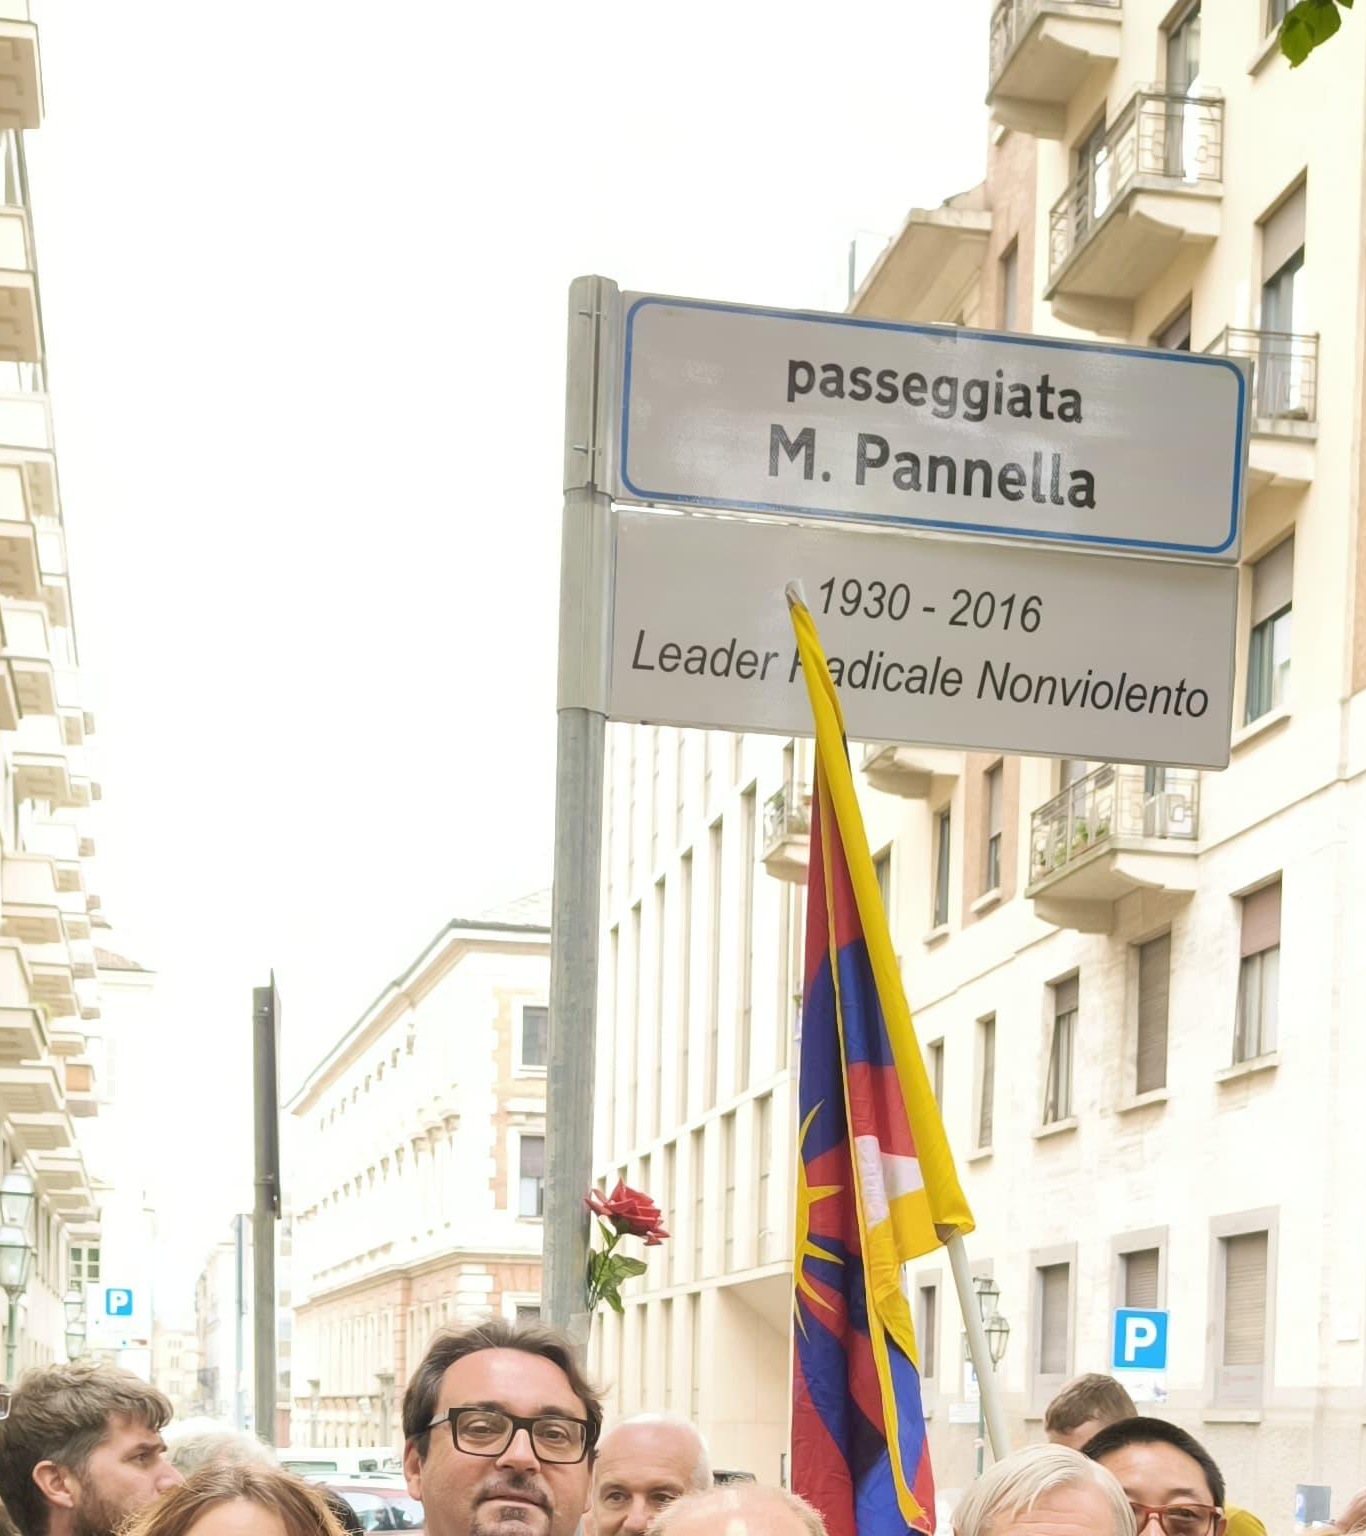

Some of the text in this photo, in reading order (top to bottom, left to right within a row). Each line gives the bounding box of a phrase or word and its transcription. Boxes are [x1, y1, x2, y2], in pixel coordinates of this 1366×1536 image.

[787, 358, 1083, 423] passeggiata
[768, 423, 1096, 510] M. Pannella
[819, 576, 911, 621] 1930
[948, 588, 1043, 633] 2016
[631, 629, 780, 681] Leader
[976, 660, 1210, 718] Nonviolento
[109, 1290, 129, 1314] P
[1124, 1316, 1158, 1362] P
